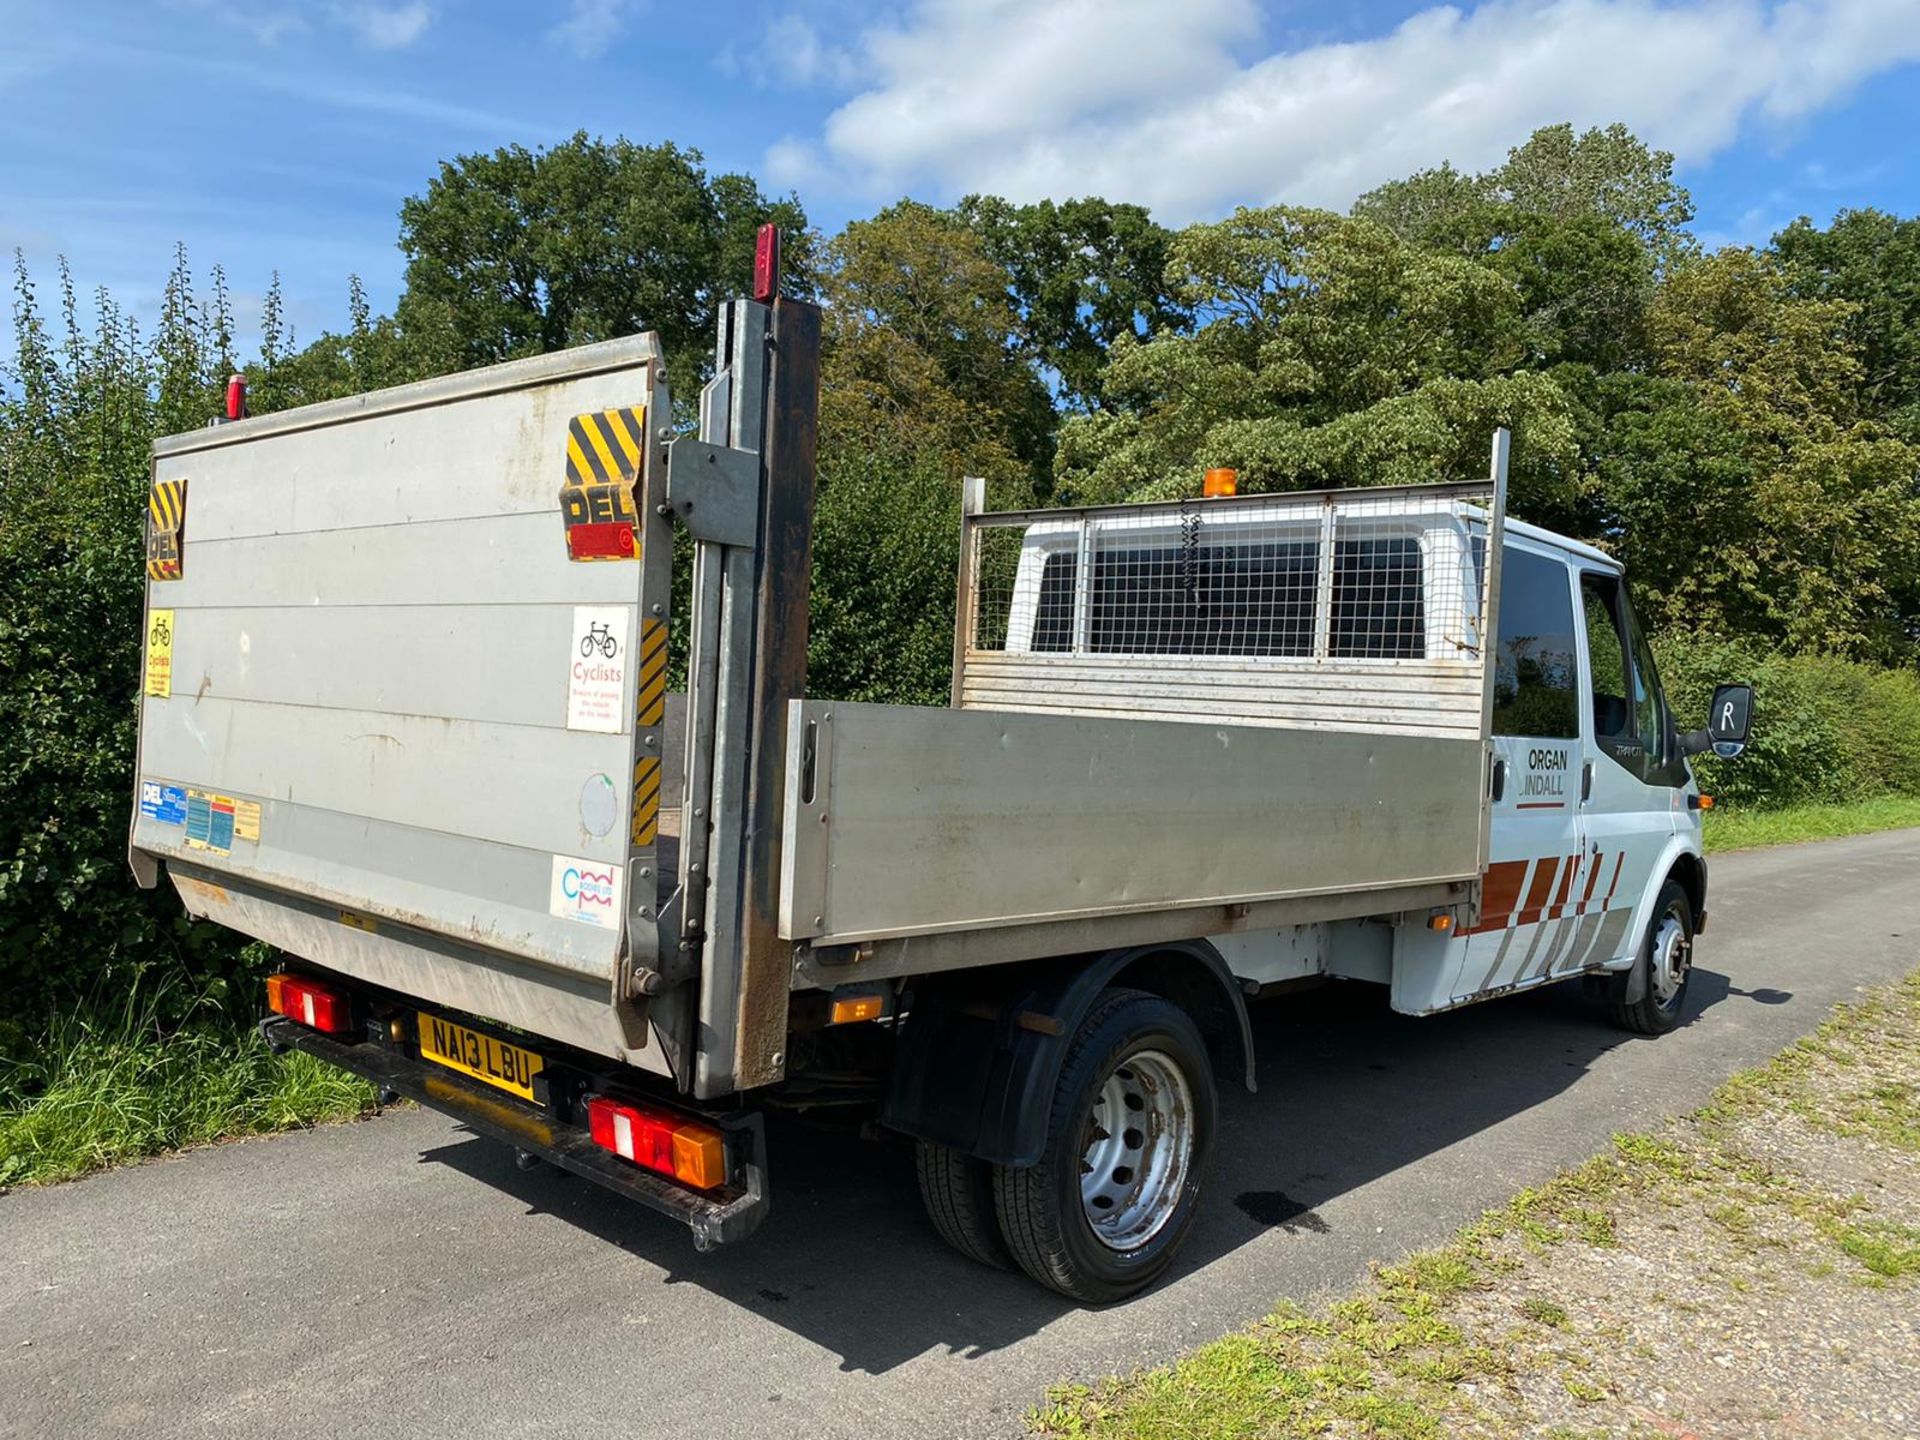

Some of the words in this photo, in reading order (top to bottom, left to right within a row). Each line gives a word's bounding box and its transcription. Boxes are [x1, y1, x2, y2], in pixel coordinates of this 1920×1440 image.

[559, 486, 636, 526] DEL
[148, 534, 177, 560] DEL
[572, 661, 622, 686] Cyclists
[1720, 701, 1735, 731] R
[1528, 749, 1568, 771] ORGAN
[143, 783, 164, 806] DEL
[432, 1019, 482, 1069] NA13
[485, 1039, 531, 1089] LBU
